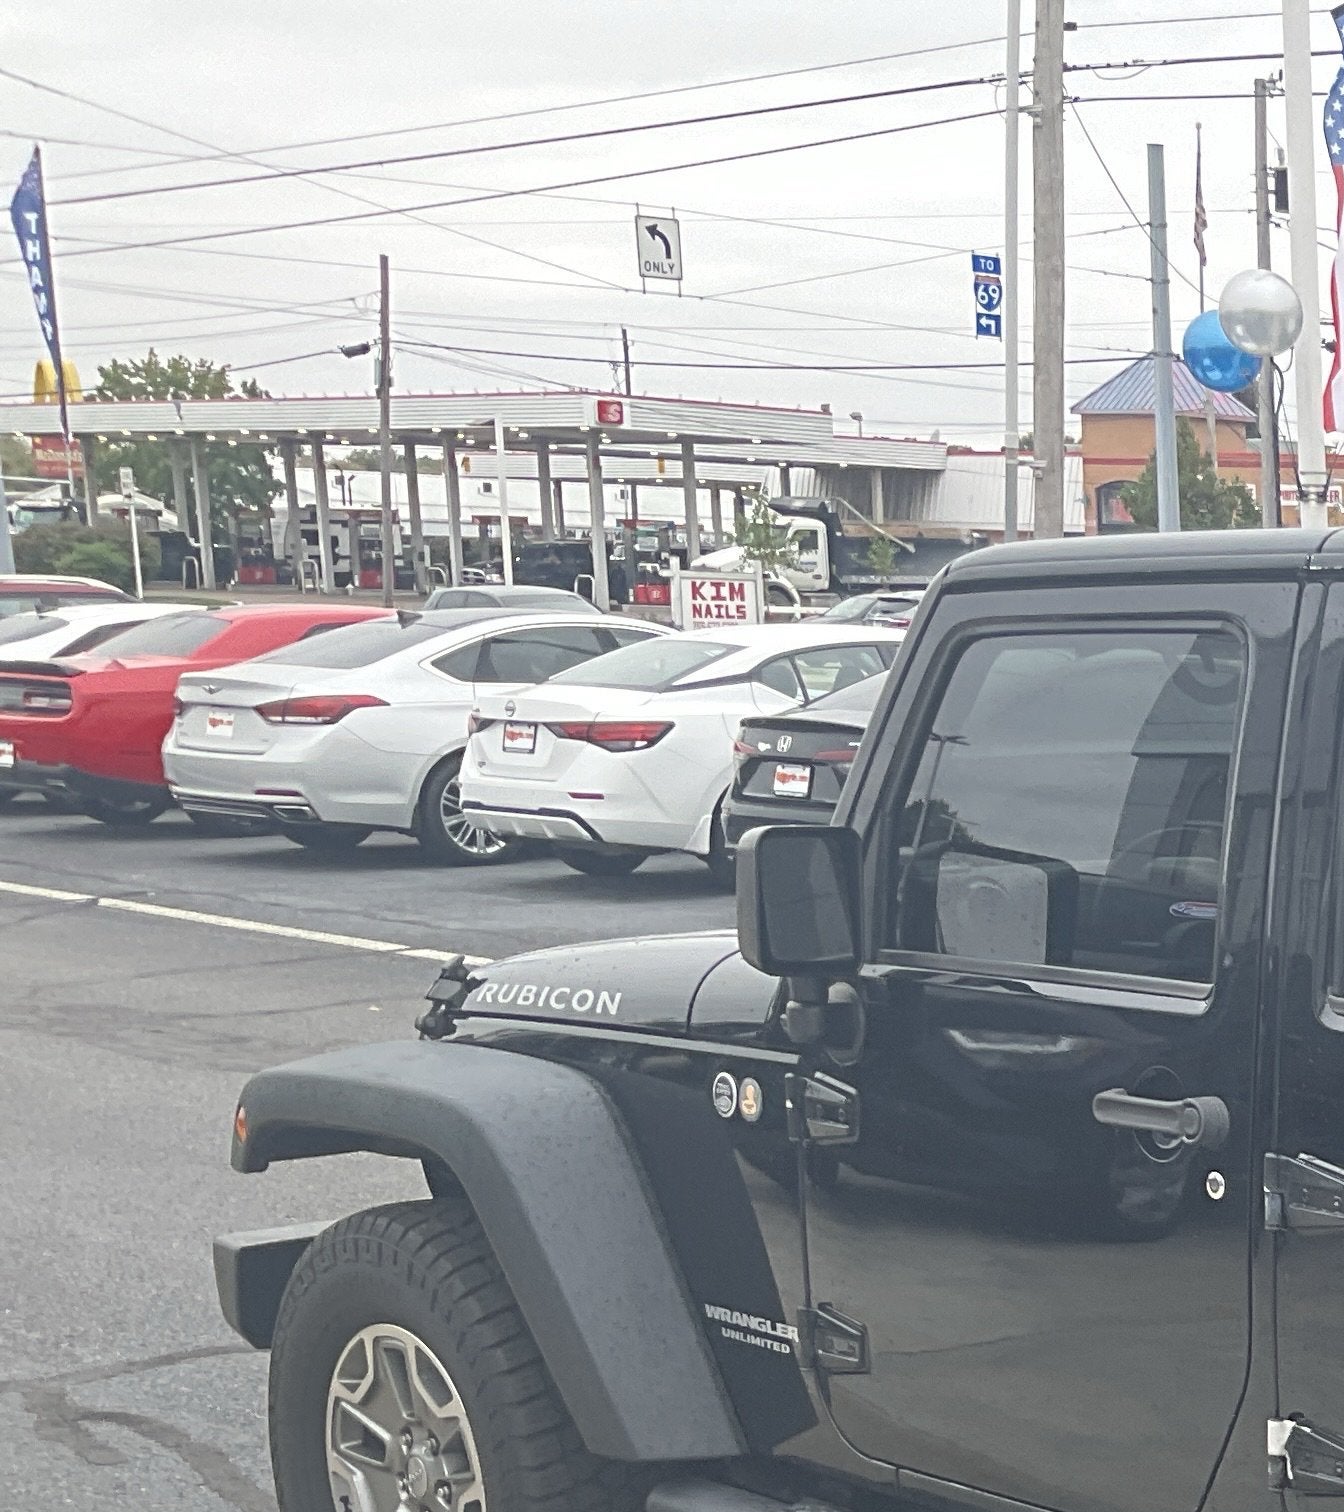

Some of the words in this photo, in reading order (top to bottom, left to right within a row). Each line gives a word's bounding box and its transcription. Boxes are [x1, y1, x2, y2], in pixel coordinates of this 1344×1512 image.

[644, 260, 675, 275] ONLY
[980, 259, 994, 271] TO
[978, 284, 1000, 305] 69
[691, 580, 746, 602] KIM
[692, 603, 747, 620] NAILS
[476, 982, 623, 1016] RUBICON
[704, 1303, 800, 1343] WRANGLER
[721, 1326, 791, 1354] UNLIMITED
